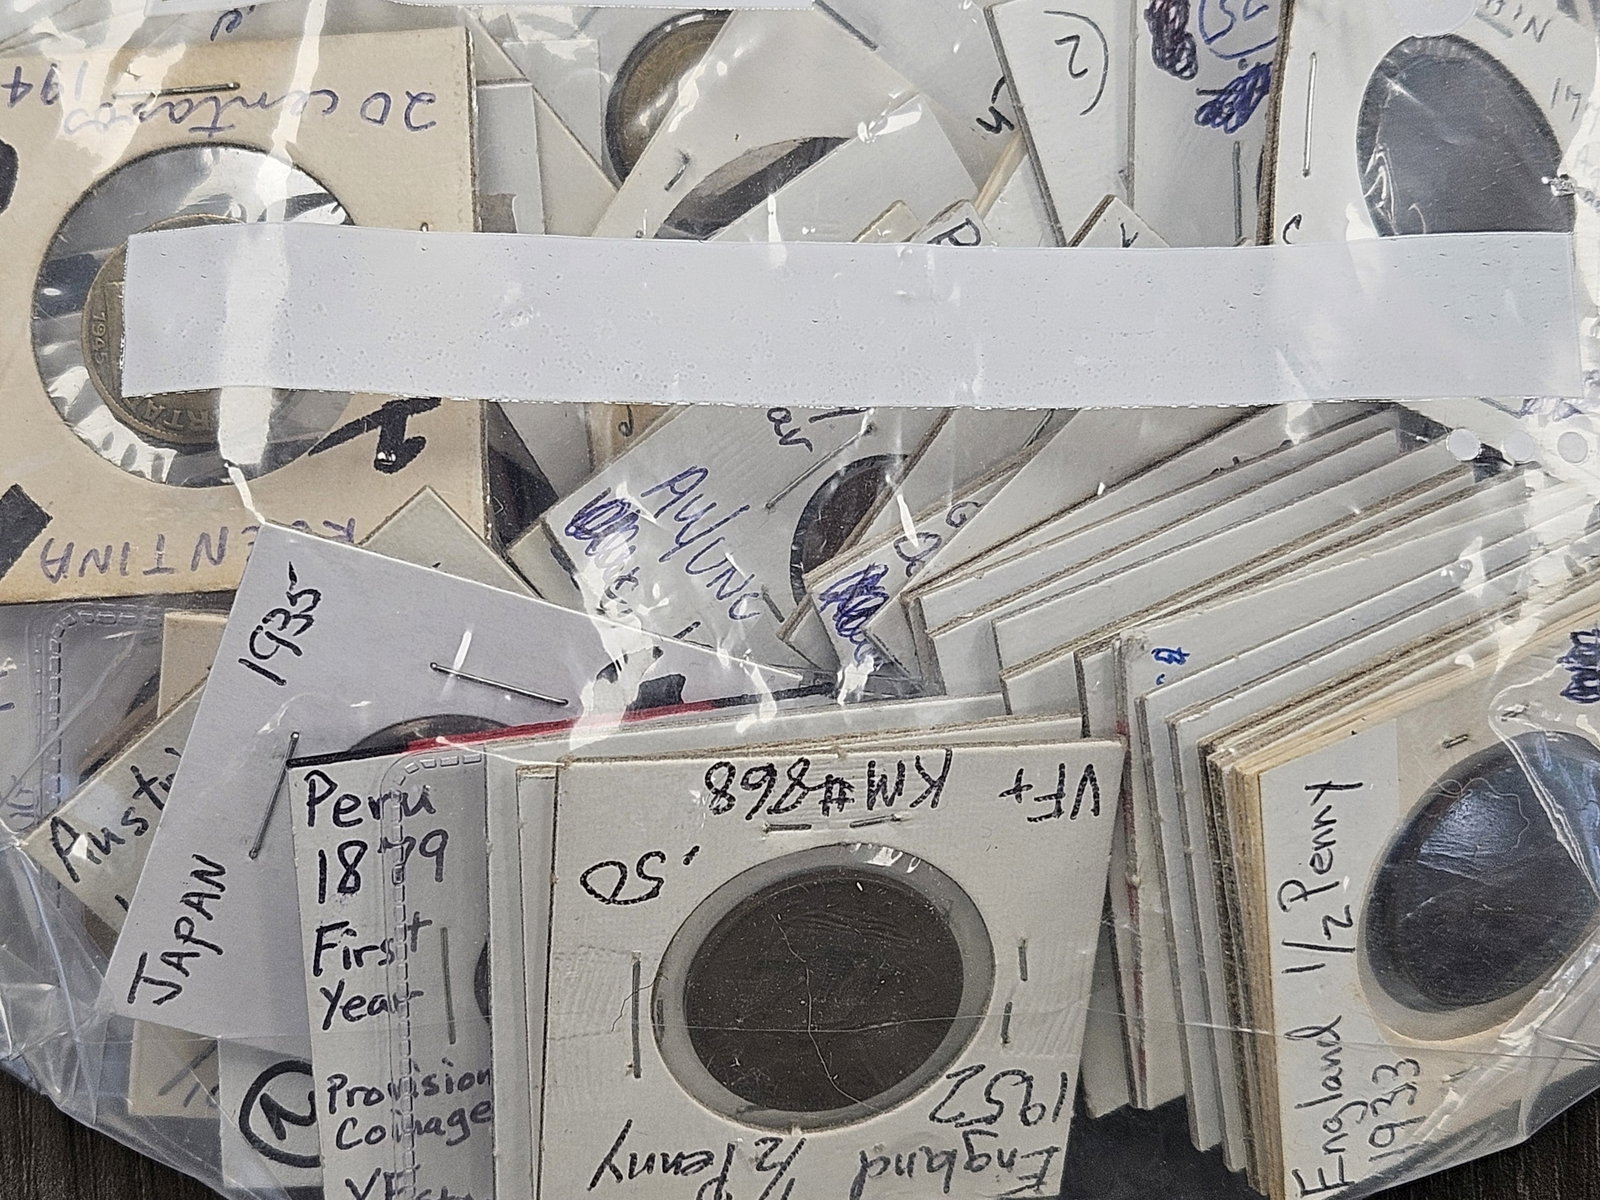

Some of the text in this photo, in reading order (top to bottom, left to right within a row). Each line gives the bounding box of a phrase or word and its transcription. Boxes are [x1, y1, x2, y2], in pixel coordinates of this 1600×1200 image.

[360, 91, 438, 132] 20
[237, 560, 322, 687] 1935
[303, 769, 437, 828] Peru
[1000, 763, 1101, 822] VF+
[127, 853, 227, 1005] JAPAN
[313, 911, 433, 978] First
[319, 978, 425, 1031] Year
[1277, 781, 1368, 1198] England 1/2 Penny
[928, 1063, 1069, 1128] 1952
[1368, 1057, 1427, 1163] 1933
